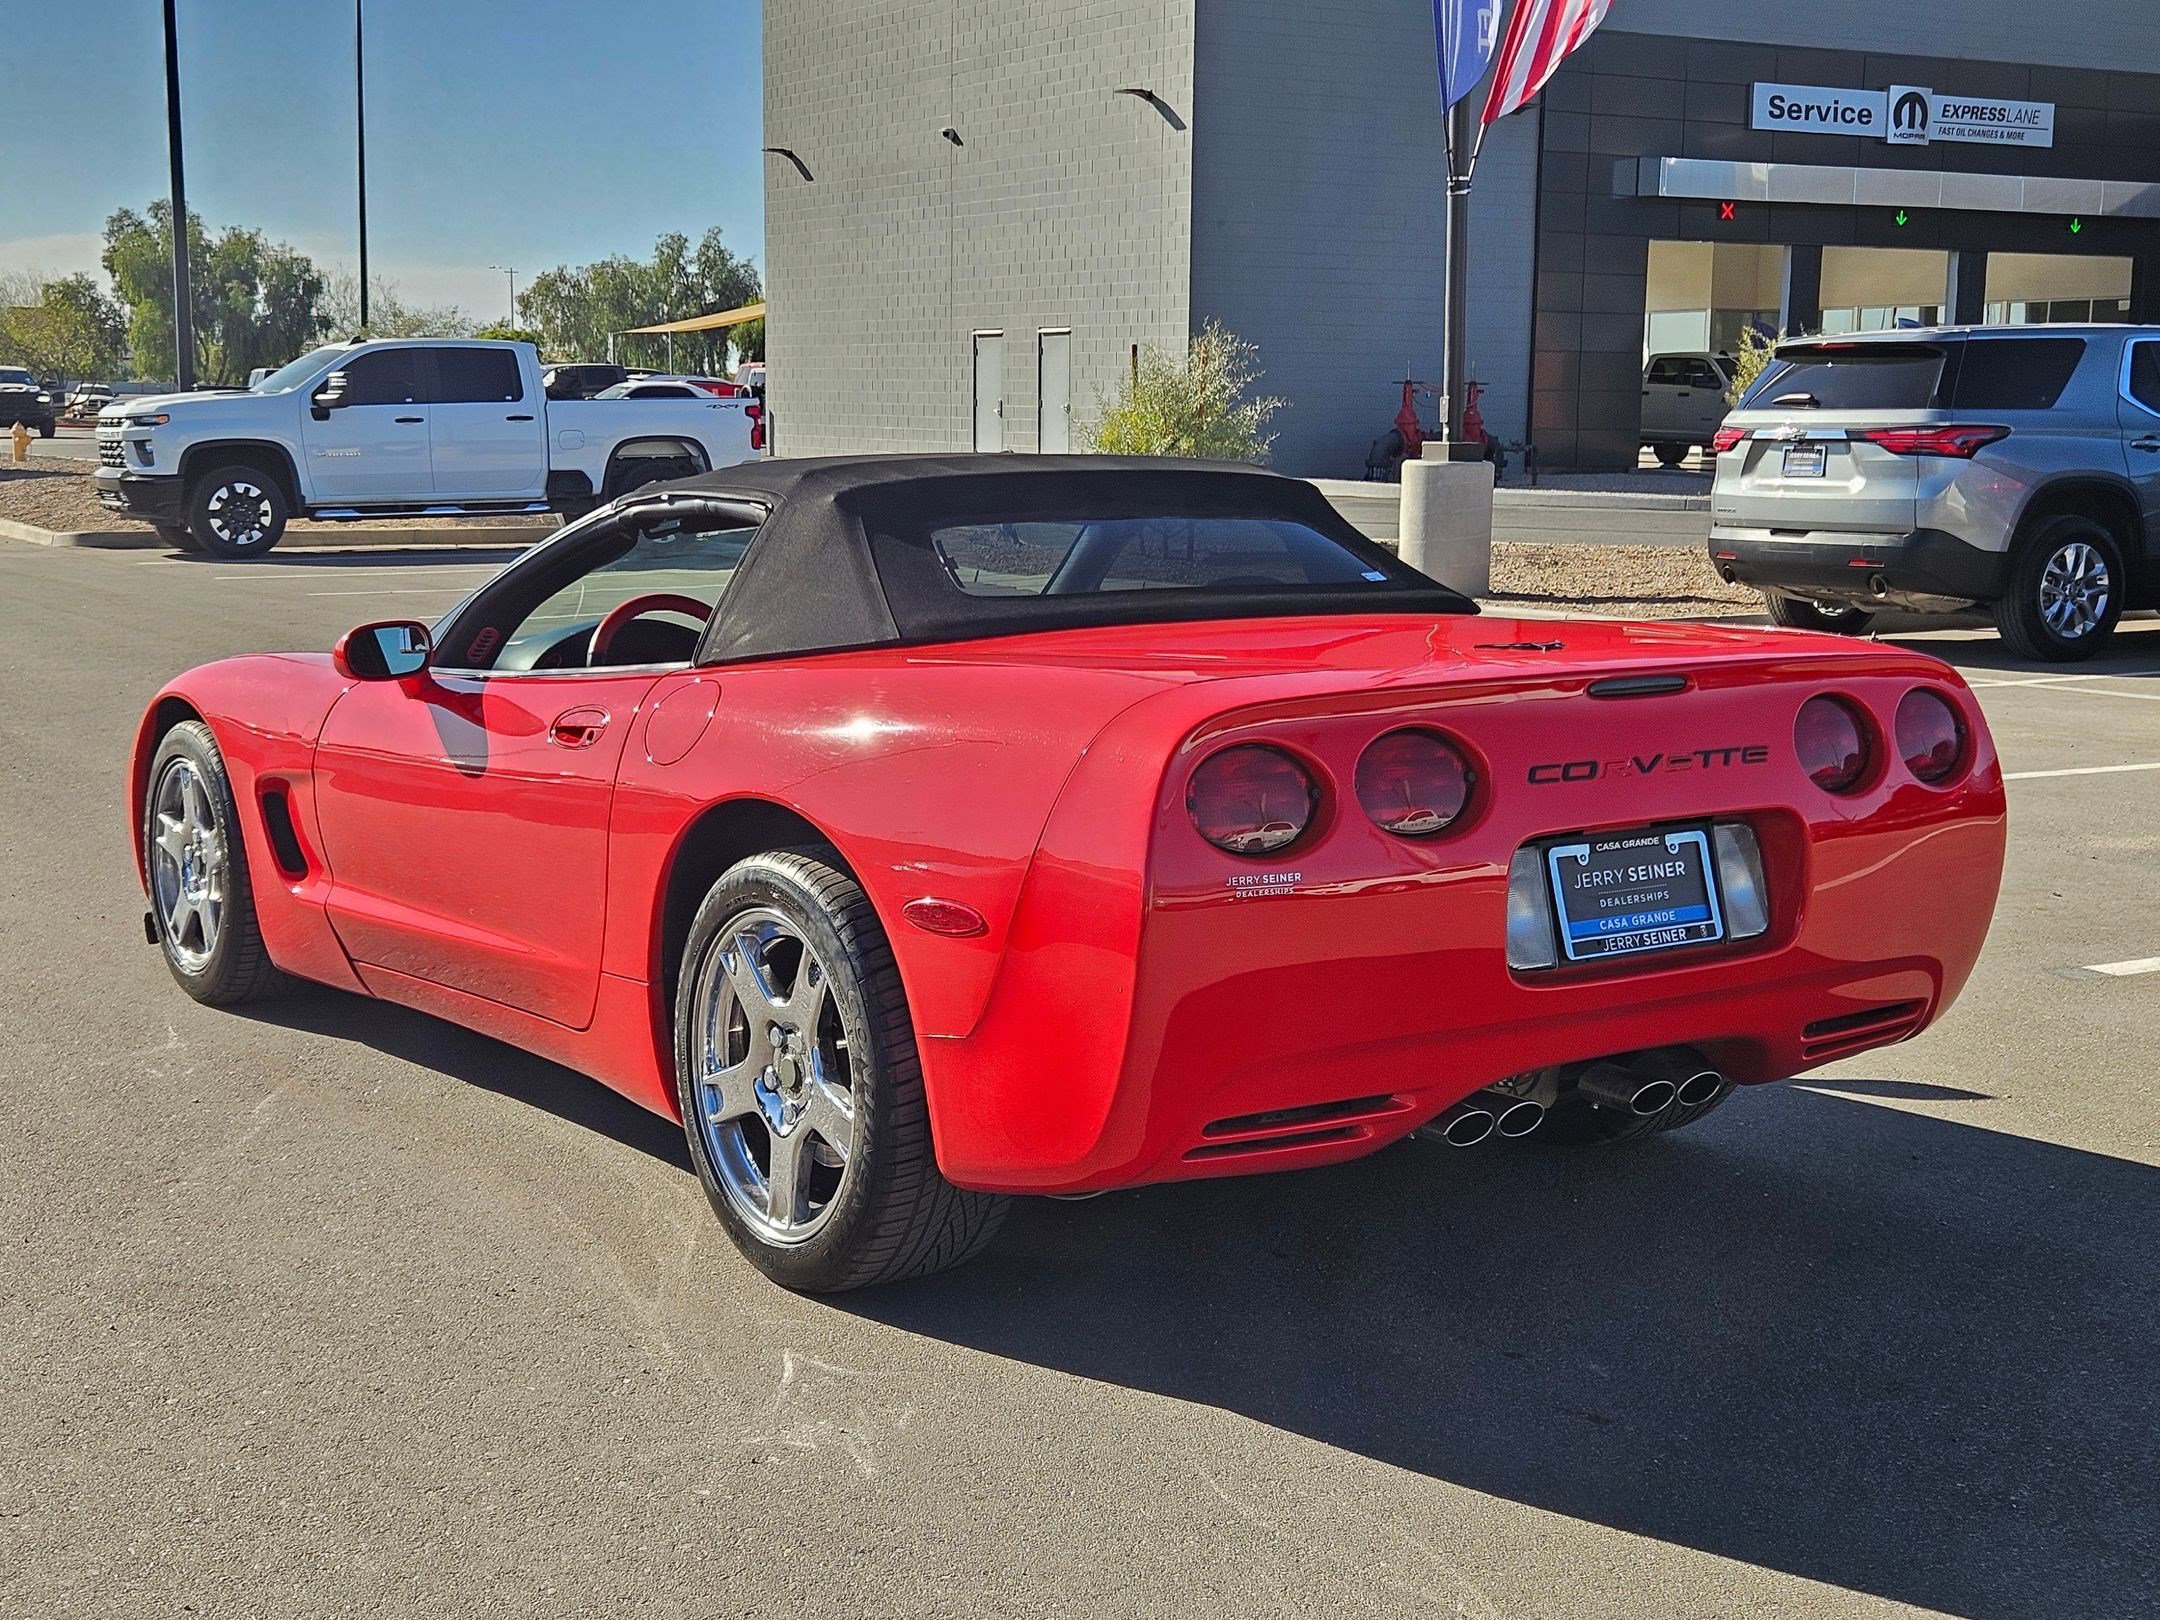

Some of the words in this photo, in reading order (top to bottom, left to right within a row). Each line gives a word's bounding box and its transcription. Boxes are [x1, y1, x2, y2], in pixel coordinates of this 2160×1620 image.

[1768, 95, 1872, 125] Service
[1893, 132, 1926, 141] MOPAR
[1937, 126, 1955, 135] FAST
[1955, 127, 1966, 137] OIL
[1967, 128, 1998, 139] CHANGES
[1999, 130, 2005, 139] &
[2005, 131, 2025, 140] MORE
[1527, 745, 1769, 785] CORVETTE
[1595, 842, 1621, 852] CASA
[1621, 837, 1660, 850] GRANDE
[1226, 875, 1260, 886] JERRY
[1263, 873, 1301, 883] SEINER
[1574, 868, 1624, 889] JERRY
[1627, 861, 1686, 883] SEINER
[1236, 888, 1294, 898] DEALERSHIPS
[1599, 890, 1670, 908] DEALERSHIPS
[1599, 919, 1628, 931] CASA
[1631, 911, 1676, 927] GRANDE
[1603, 935, 1641, 952] JERRY
[1643, 928, 1687, 946] SEINER
